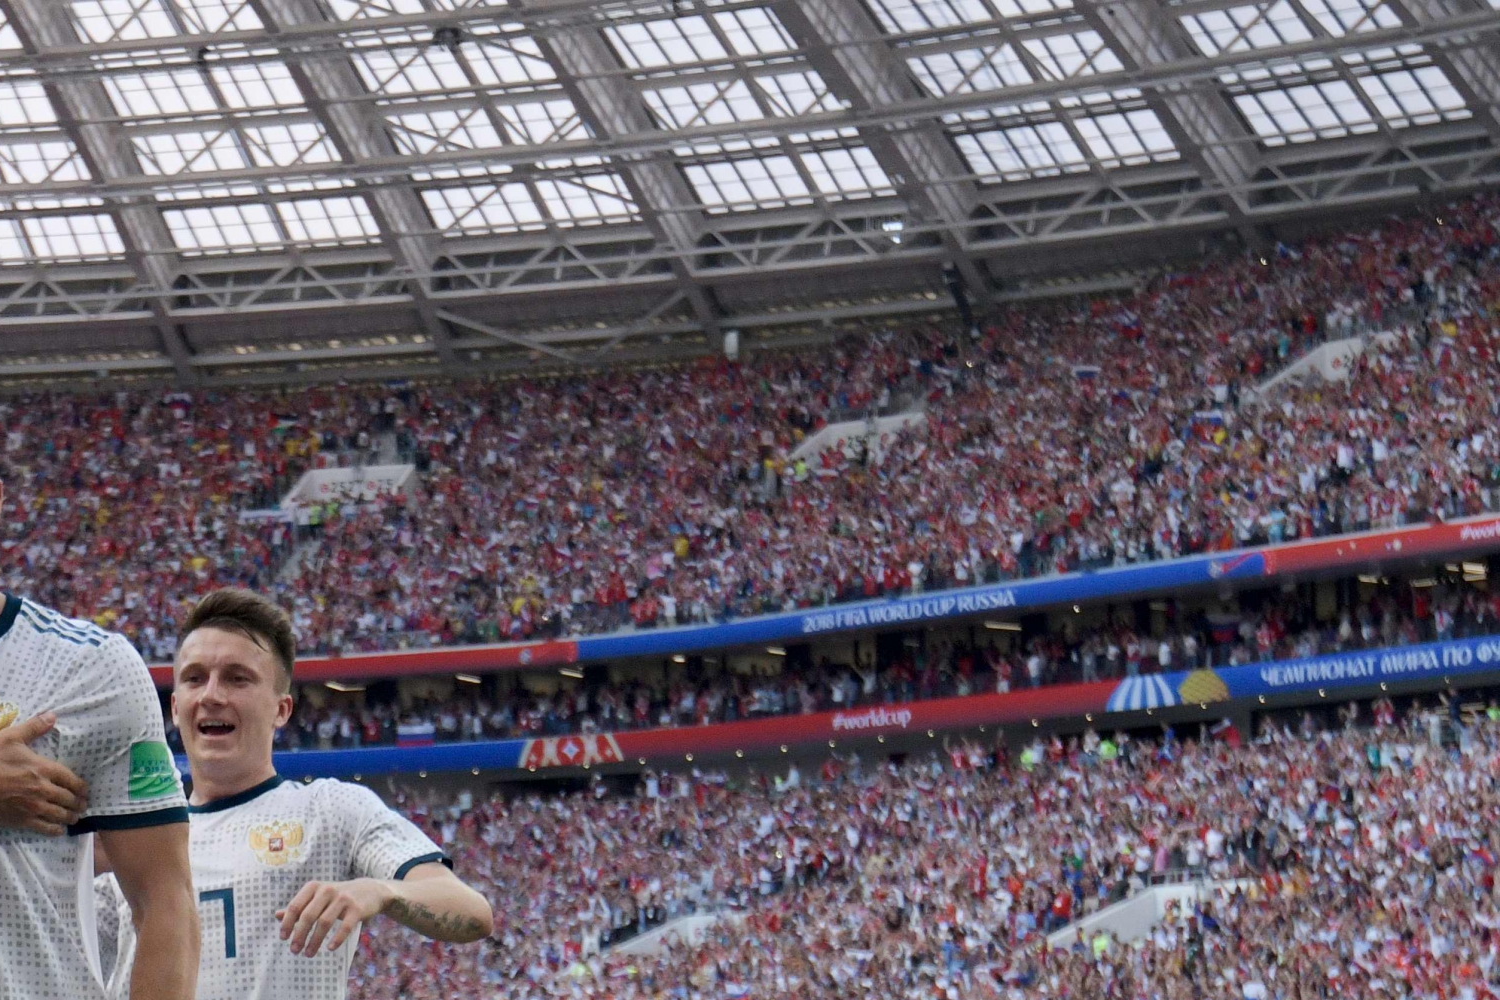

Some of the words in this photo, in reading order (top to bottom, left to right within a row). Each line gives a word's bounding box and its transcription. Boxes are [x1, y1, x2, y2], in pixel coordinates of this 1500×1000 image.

[803, 616, 834, 633] 2018
[835, 610, 867, 628] FIFA
[868, 602, 922, 624] WORLD
[923, 599, 955, 618] CUP
[956, 590, 1015, 613] RUSSIA
[1260, 656, 1376, 687] ЧЕМПИОНАТ
[1380, 649, 1439, 675] МИРА
[1442, 645, 1472, 667] ПО
[832, 706, 911, 730] #worldcup
[199, 888, 237, 958] 7
